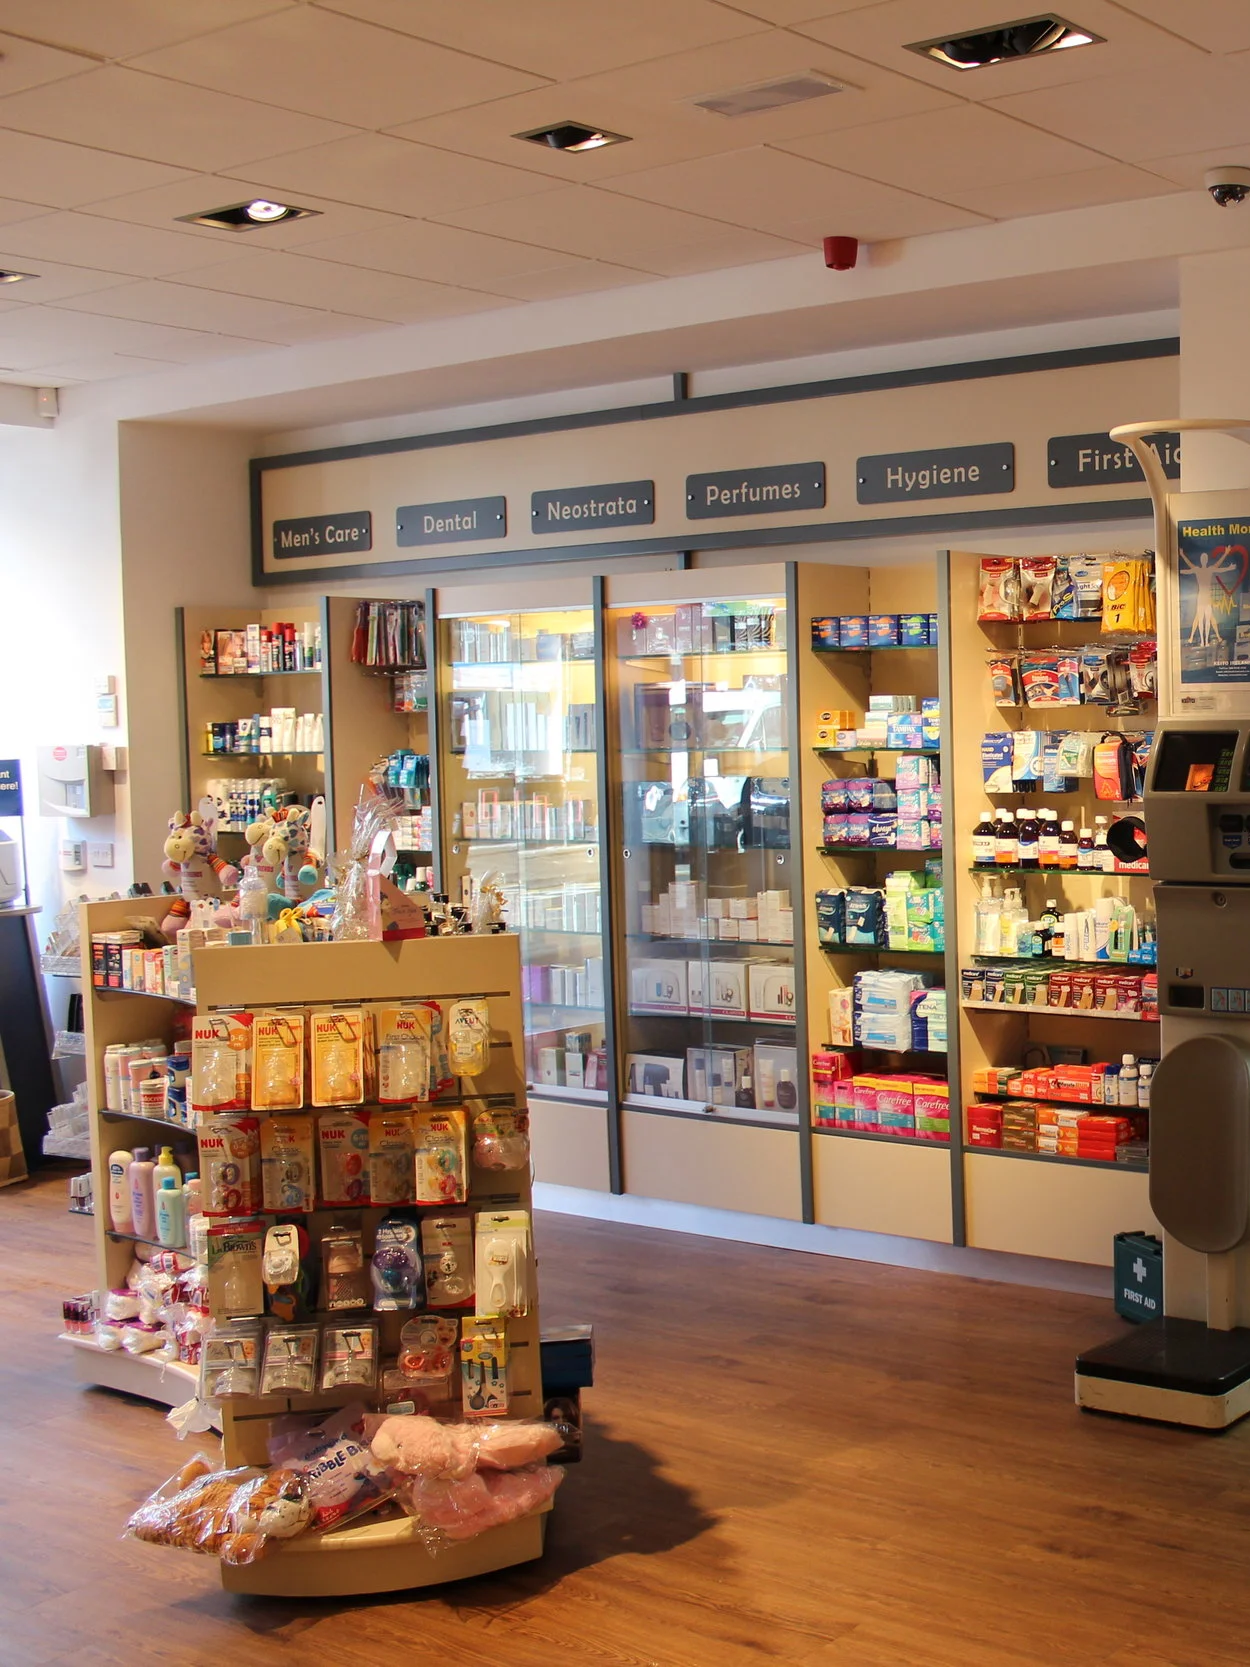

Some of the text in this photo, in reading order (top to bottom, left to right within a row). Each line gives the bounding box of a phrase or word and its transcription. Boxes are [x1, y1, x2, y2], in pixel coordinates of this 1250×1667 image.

[1079, 447, 1133, 472] First
[886, 464, 980, 492] Hygiene
[706, 482, 801, 505] Perfumes
[547, 498, 638, 521] Neostrata
[423, 511, 477, 534] Dental
[281, 525, 359, 549] Men's Care
[1182, 524, 1225, 537] Health
[1115, 613, 1120, 623] 1
[258, 1026, 278, 1036] NUK
[316, 1023, 336, 1033] NUK
[396, 1019, 415, 1030] NUK
[195, 1029, 221, 1040] NUK
[877, 1093, 912, 1106] Carefree
[430, 1123, 448, 1131] NUK
[321, 1130, 345, 1139] NUK
[200, 1138, 224, 1148] NUK
[1124, 1288, 1156, 1310] FIRST AID
